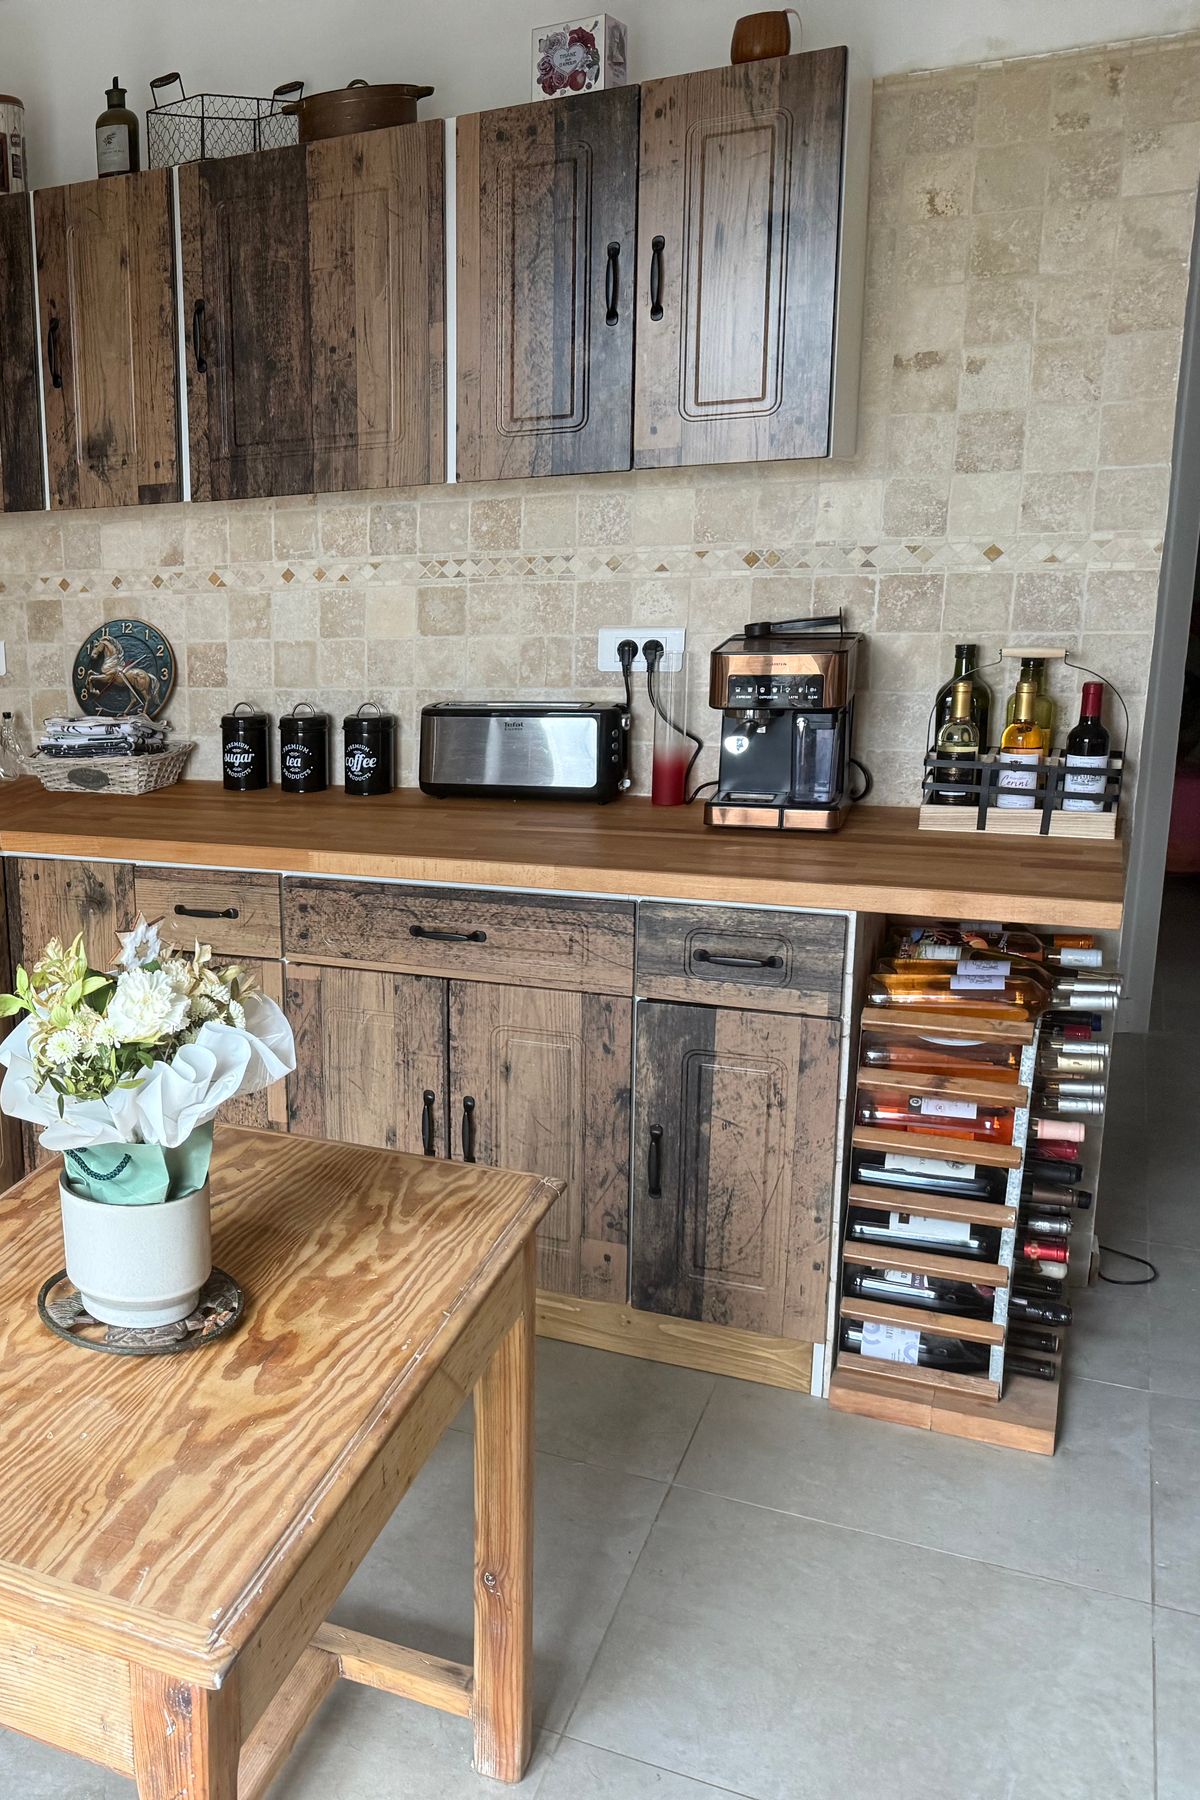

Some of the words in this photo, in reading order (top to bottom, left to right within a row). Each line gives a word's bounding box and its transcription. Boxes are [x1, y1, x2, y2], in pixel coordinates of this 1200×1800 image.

[101, 627, 109, 637] 11
[121, 622, 133, 634] 12
[145, 629, 149, 640] 1
[156, 645, 164, 657] 2
[77, 666, 86, 679] 9
[160, 667, 169, 681] 3
[80, 688, 88, 700] 8
[226, 742, 250, 750] PREMIUM
[283, 744, 309, 754] PREMIUM
[224, 753, 255, 766] sugar
[286, 755, 302, 767] tea
[345, 753, 377, 772] coffee
[226, 768, 252, 778] PRODUCTS
[283, 768, 311, 780] PRODUCTS
